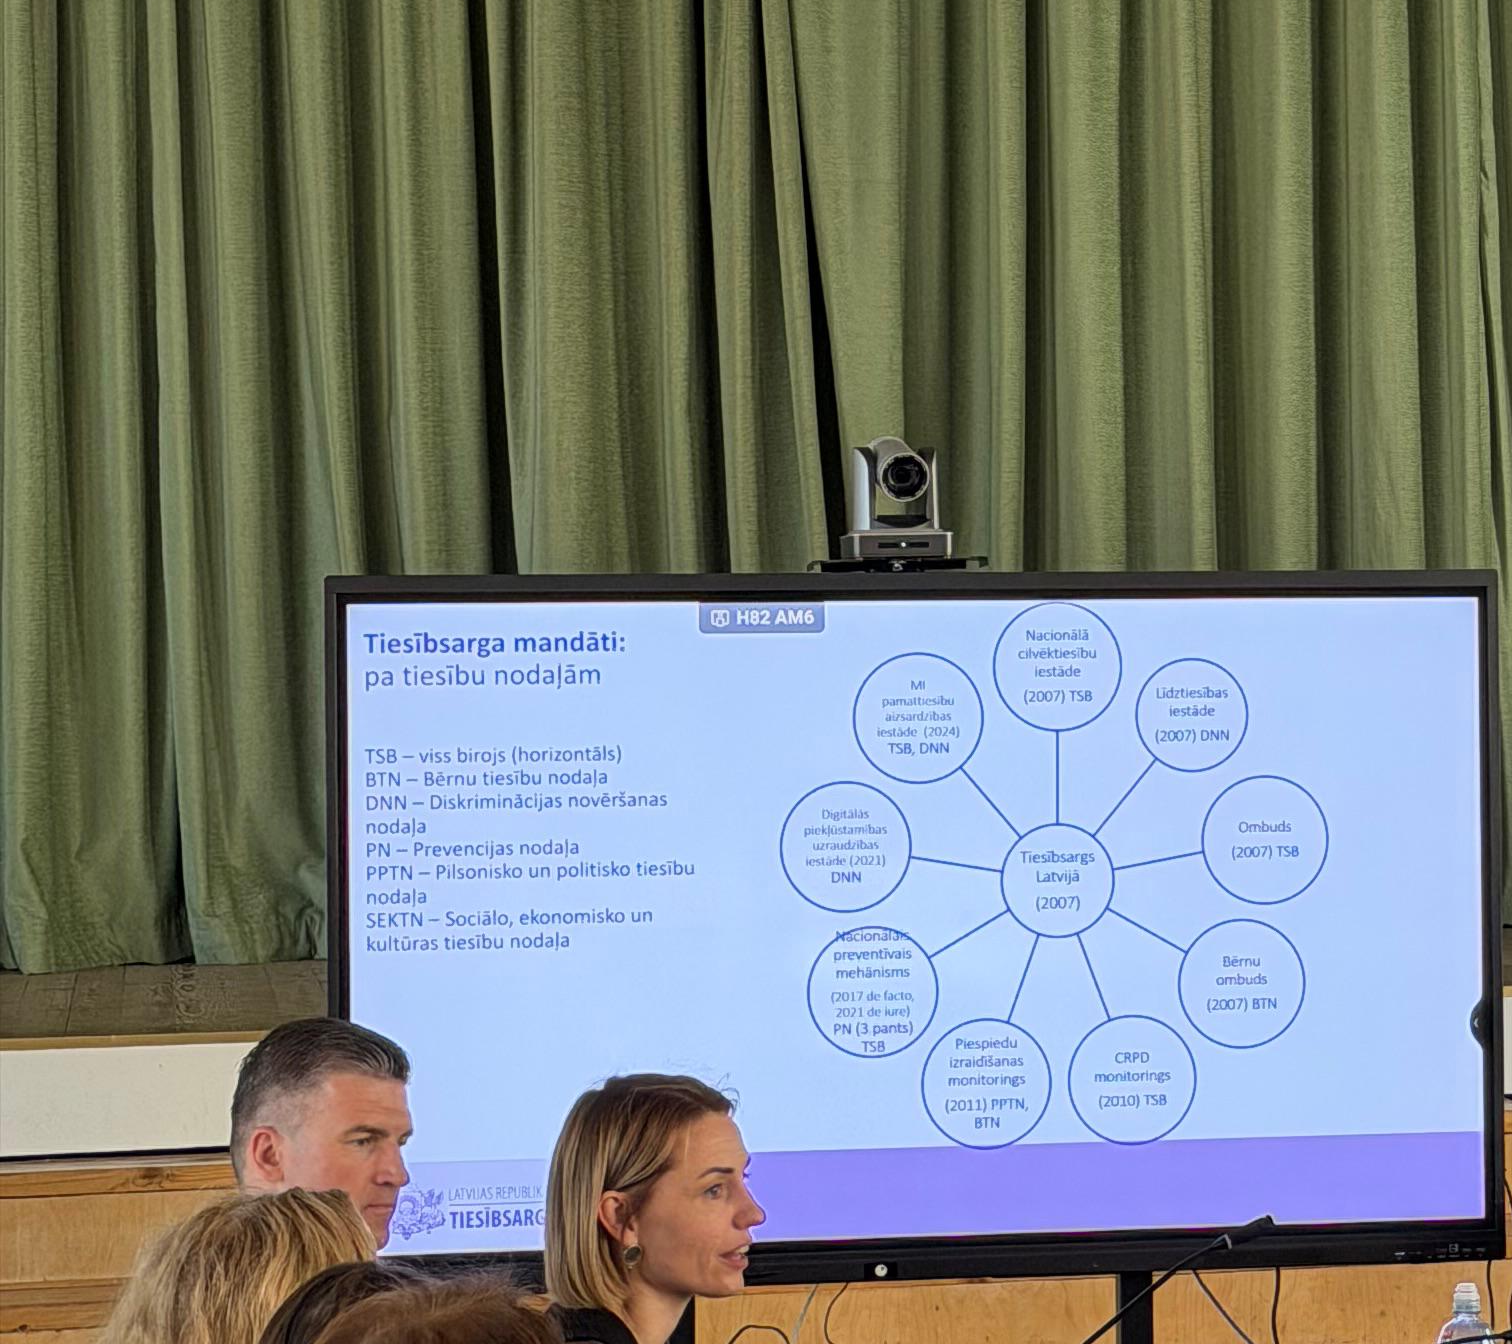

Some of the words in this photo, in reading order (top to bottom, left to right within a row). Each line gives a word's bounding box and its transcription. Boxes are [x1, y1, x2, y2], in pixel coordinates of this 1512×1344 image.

[736, 609, 770, 625] H82
[774, 609, 815, 625] AM6
[1025, 629, 1089, 641] Nacionālā
[363, 632, 504, 658] Tiesībsarga
[515, 631, 625, 652] mandāti:
[366, 671, 393, 691] pa
[403, 664, 484, 686] tiesību
[495, 664, 600, 689] nodaļām
[1034, 664, 1081, 678] iestāde
[1023, 688, 1065, 705] (2007)
[1069, 690, 1093, 702] TSB
[1169, 704, 1215, 717] iestāde
[923, 725, 960, 739] (2024)
[1155, 728, 1197, 744] (2007)
[1201, 729, 1230, 741] DNN
[365, 749, 397, 764] TSB
[419, 749, 451, 763] viss
[457, 747, 505, 766] birojs
[512, 745, 621, 765] (horizontāls)
[888, 742, 916, 756] TSB,
[920, 742, 950, 754] DNN
[366, 772, 400, 787] BTN
[424, 772, 476, 786] Bērnu
[483, 770, 541, 786] tiesību
[549, 769, 607, 787] nodaļa
[366, 796, 406, 811] DNN
[431, 793, 562, 812] Diskriminācijas
[569, 792, 667, 807] novēršanas
[366, 818, 426, 837] nodaļa
[1238, 820, 1292, 833] Ombuds
[367, 843, 390, 857] PN
[414, 841, 513, 859] Prevencijas
[520, 839, 579, 857] nodaļa
[1231, 845, 1273, 861] (2007)
[1276, 845, 1300, 857] TSB
[849, 854, 886, 868] (2021)
[1020, 850, 1096, 866] Tiesībsargs
[367, 866, 412, 880] PPTN
[437, 863, 522, 880] Pilsonisko
[529, 867, 550, 878] un
[557, 861, 630, 881] politisko
[637, 860, 694, 876] tiesību
[831, 871, 862, 883] DNN
[1036, 869, 1080, 885] Latvijā
[367, 888, 426, 907] nodaļa
[1035, 895, 1081, 912] (2007)
[367, 912, 422, 928] SEKTN
[446, 910, 513, 928] Sociālo,
[520, 908, 625, 925] ekonomisko
[631, 911, 652, 922] un
[367, 936, 438, 951] kultūras
[444, 934, 503, 950] tiesību
[511, 932, 569, 950] nodaļa
[1215, 973, 1268, 986] ombuds
[831, 991, 864, 1005] (2017
[866, 991, 881, 1002] de
[1206, 997, 1248, 1014] (2007)
[1252, 997, 1278, 1010] BTN
[867, 1007, 881, 1017] de
[833, 1023, 852, 1035] PN
[856, 1022, 868, 1037] (3
[872, 1021, 914, 1037] pants)
[861, 1040, 886, 1053] TSB
[955, 1036, 1018, 1051] Piespiedu
[1114, 1051, 1150, 1064] CRPD
[948, 1073, 1026, 1088] monitorings
[1093, 1069, 1172, 1084] monitorings
[944, 1097, 987, 1115] (2011)
[991, 1097, 1029, 1112] PPTN,
[1098, 1094, 1140, 1110] (2010)
[1143, 1094, 1167, 1106] TSB
[974, 1116, 1000, 1129] BTN
[495, 1184, 543, 1200] REPUBLIK
[449, 1206, 545, 1229] TIESĪBSARG
